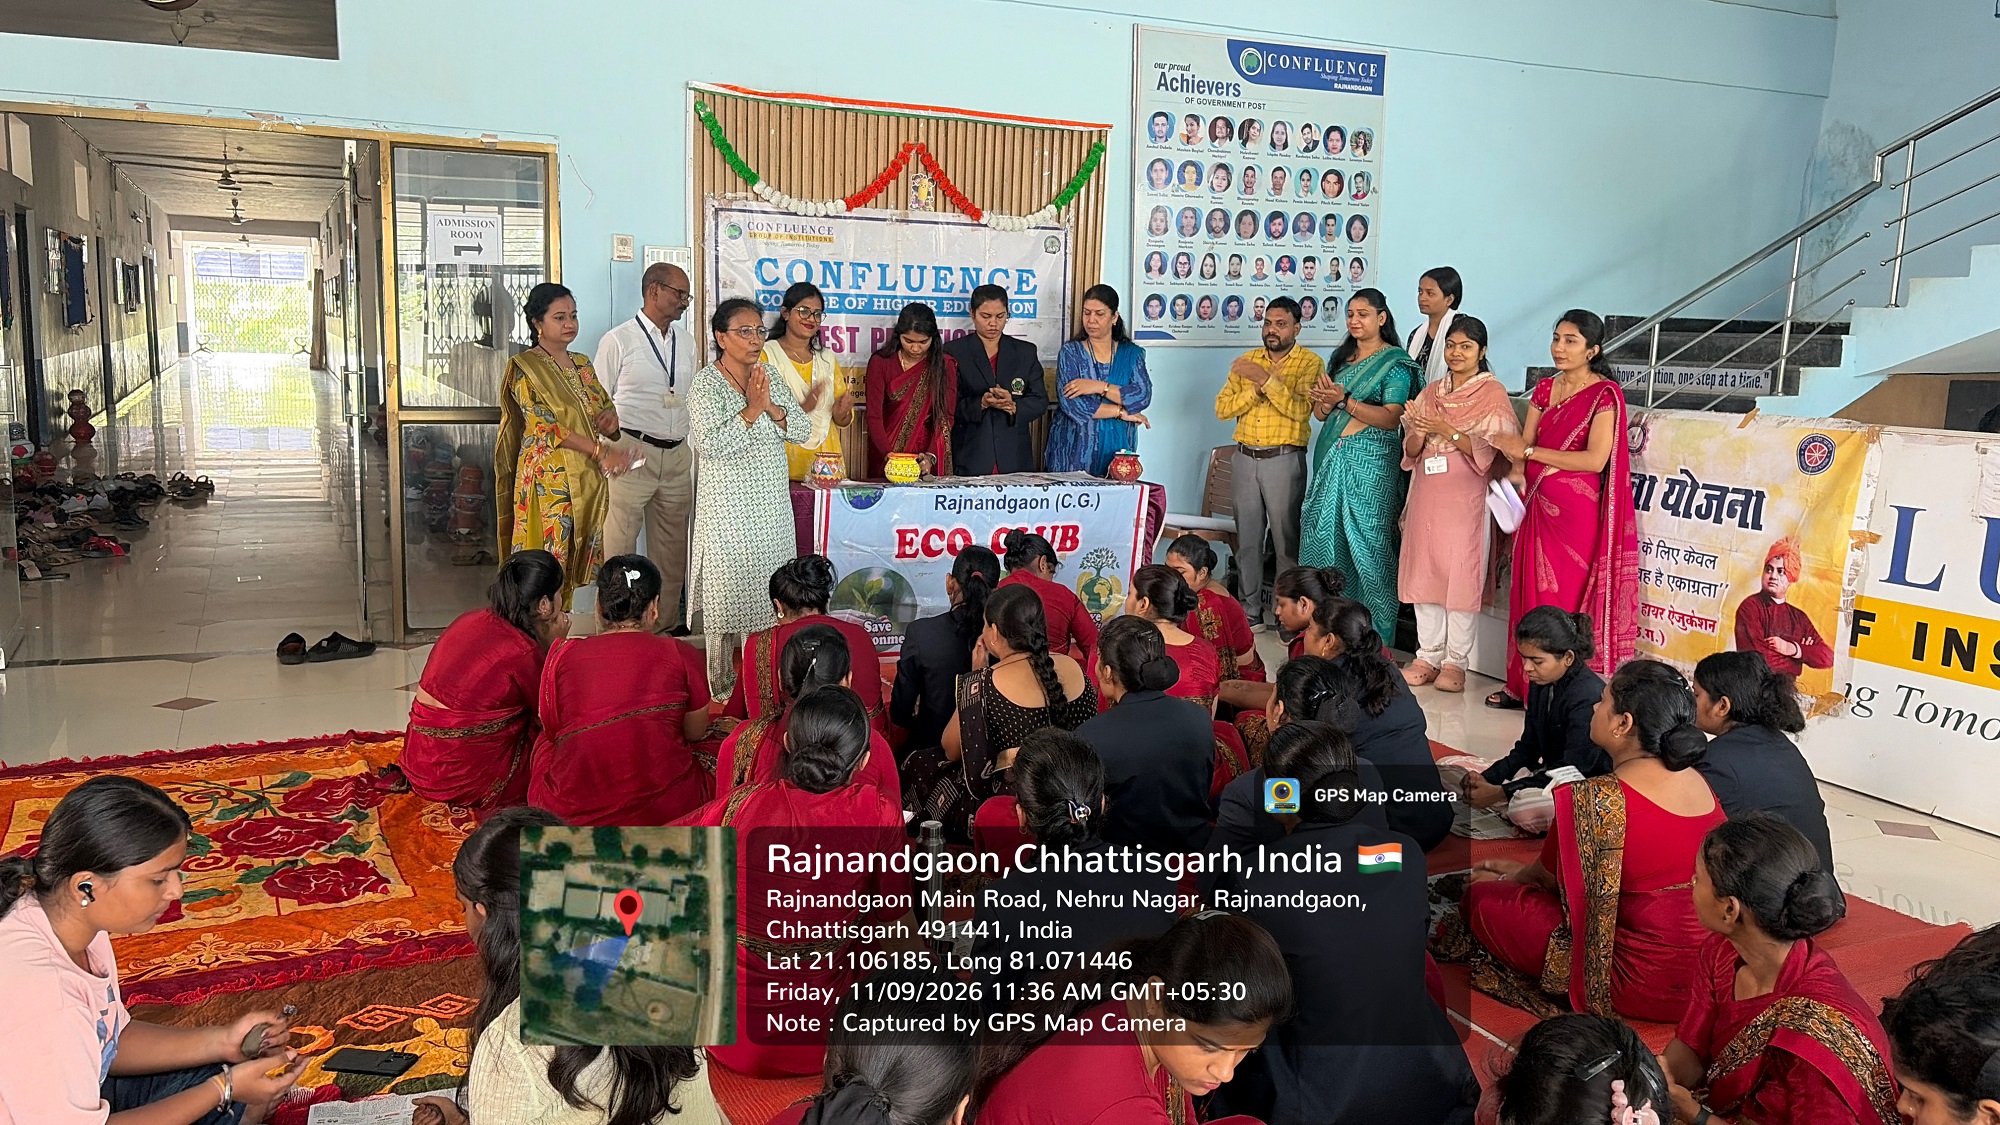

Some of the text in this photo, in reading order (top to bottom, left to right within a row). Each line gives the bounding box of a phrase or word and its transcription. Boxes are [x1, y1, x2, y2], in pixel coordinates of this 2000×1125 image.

[1153, 62, 1191, 72] our proud
[1267, 53, 1378, 77] CONFLUENCE
[1156, 72, 1241, 97] Achievers
[1334, 82, 1373, 92] RAJNANDGAON
[1184, 97, 1266, 111] OF GOVERNMENT POST
[436, 218, 496, 229] ADMISSION
[747, 221, 834, 236] CONFLUENCE
[450, 230, 483, 240] ROOM
[749, 232, 771, 240] GROUP
[785, 234, 833, 242] INSTITUTIONS
[755, 257, 1038, 296] CONFLUENCE
[845, 296, 867, 310] OF
[1678, 373, 1694, 385] one
[1696, 371, 1716, 390] step
[1719, 373, 1728, 387] at
[1730, 376, 1736, 387] a
[934, 492, 1101, 515] Rajnandgaon (C.G.)
[1661, 467, 1766, 532] योजना
[895, 527, 973, 559] ECO
[1641, 537, 1719, 570] के लिए केवल
[1654, 566, 1665, 588] है
[1641, 602, 1666, 621] हायर
[863, 620, 892, 633] Save
